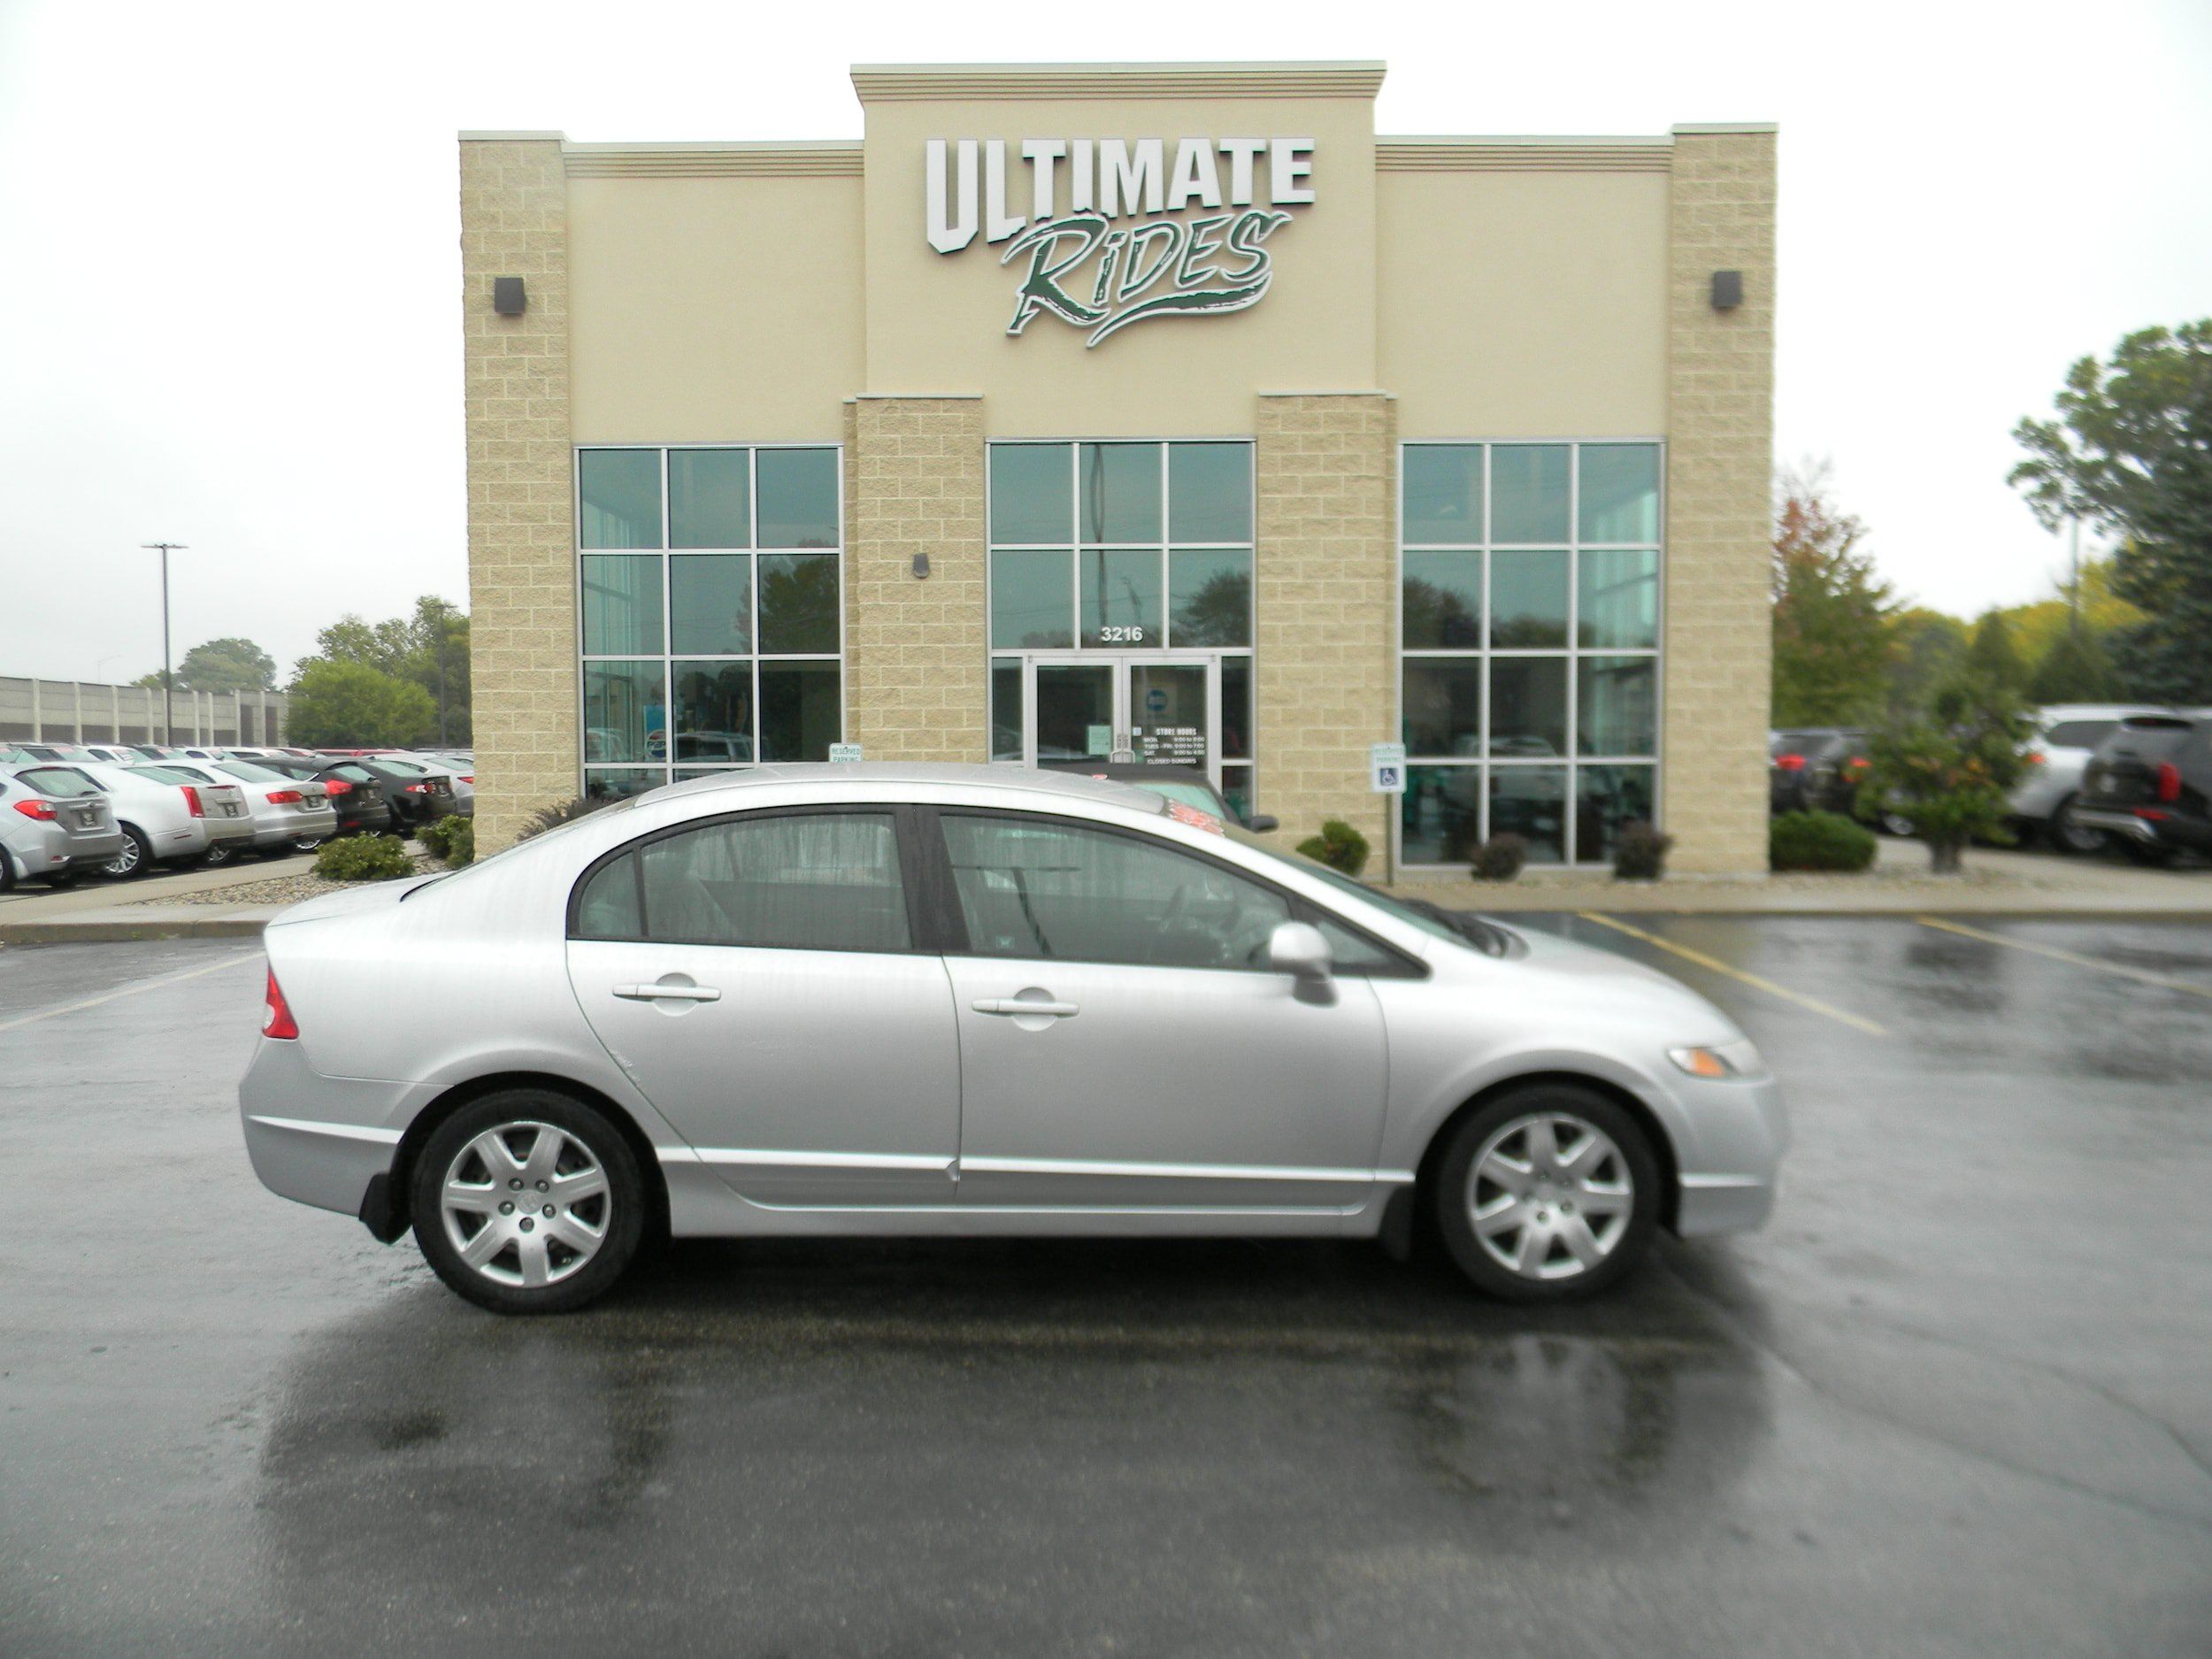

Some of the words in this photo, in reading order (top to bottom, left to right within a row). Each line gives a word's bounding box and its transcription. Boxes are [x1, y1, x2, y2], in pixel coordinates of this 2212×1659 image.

[926, 138, 1317, 255] ULTIMATE
[1101, 626, 1143, 642] 3216
[1156, 727, 1175, 736] STORE
[1177, 727, 1197, 736] HOURS
